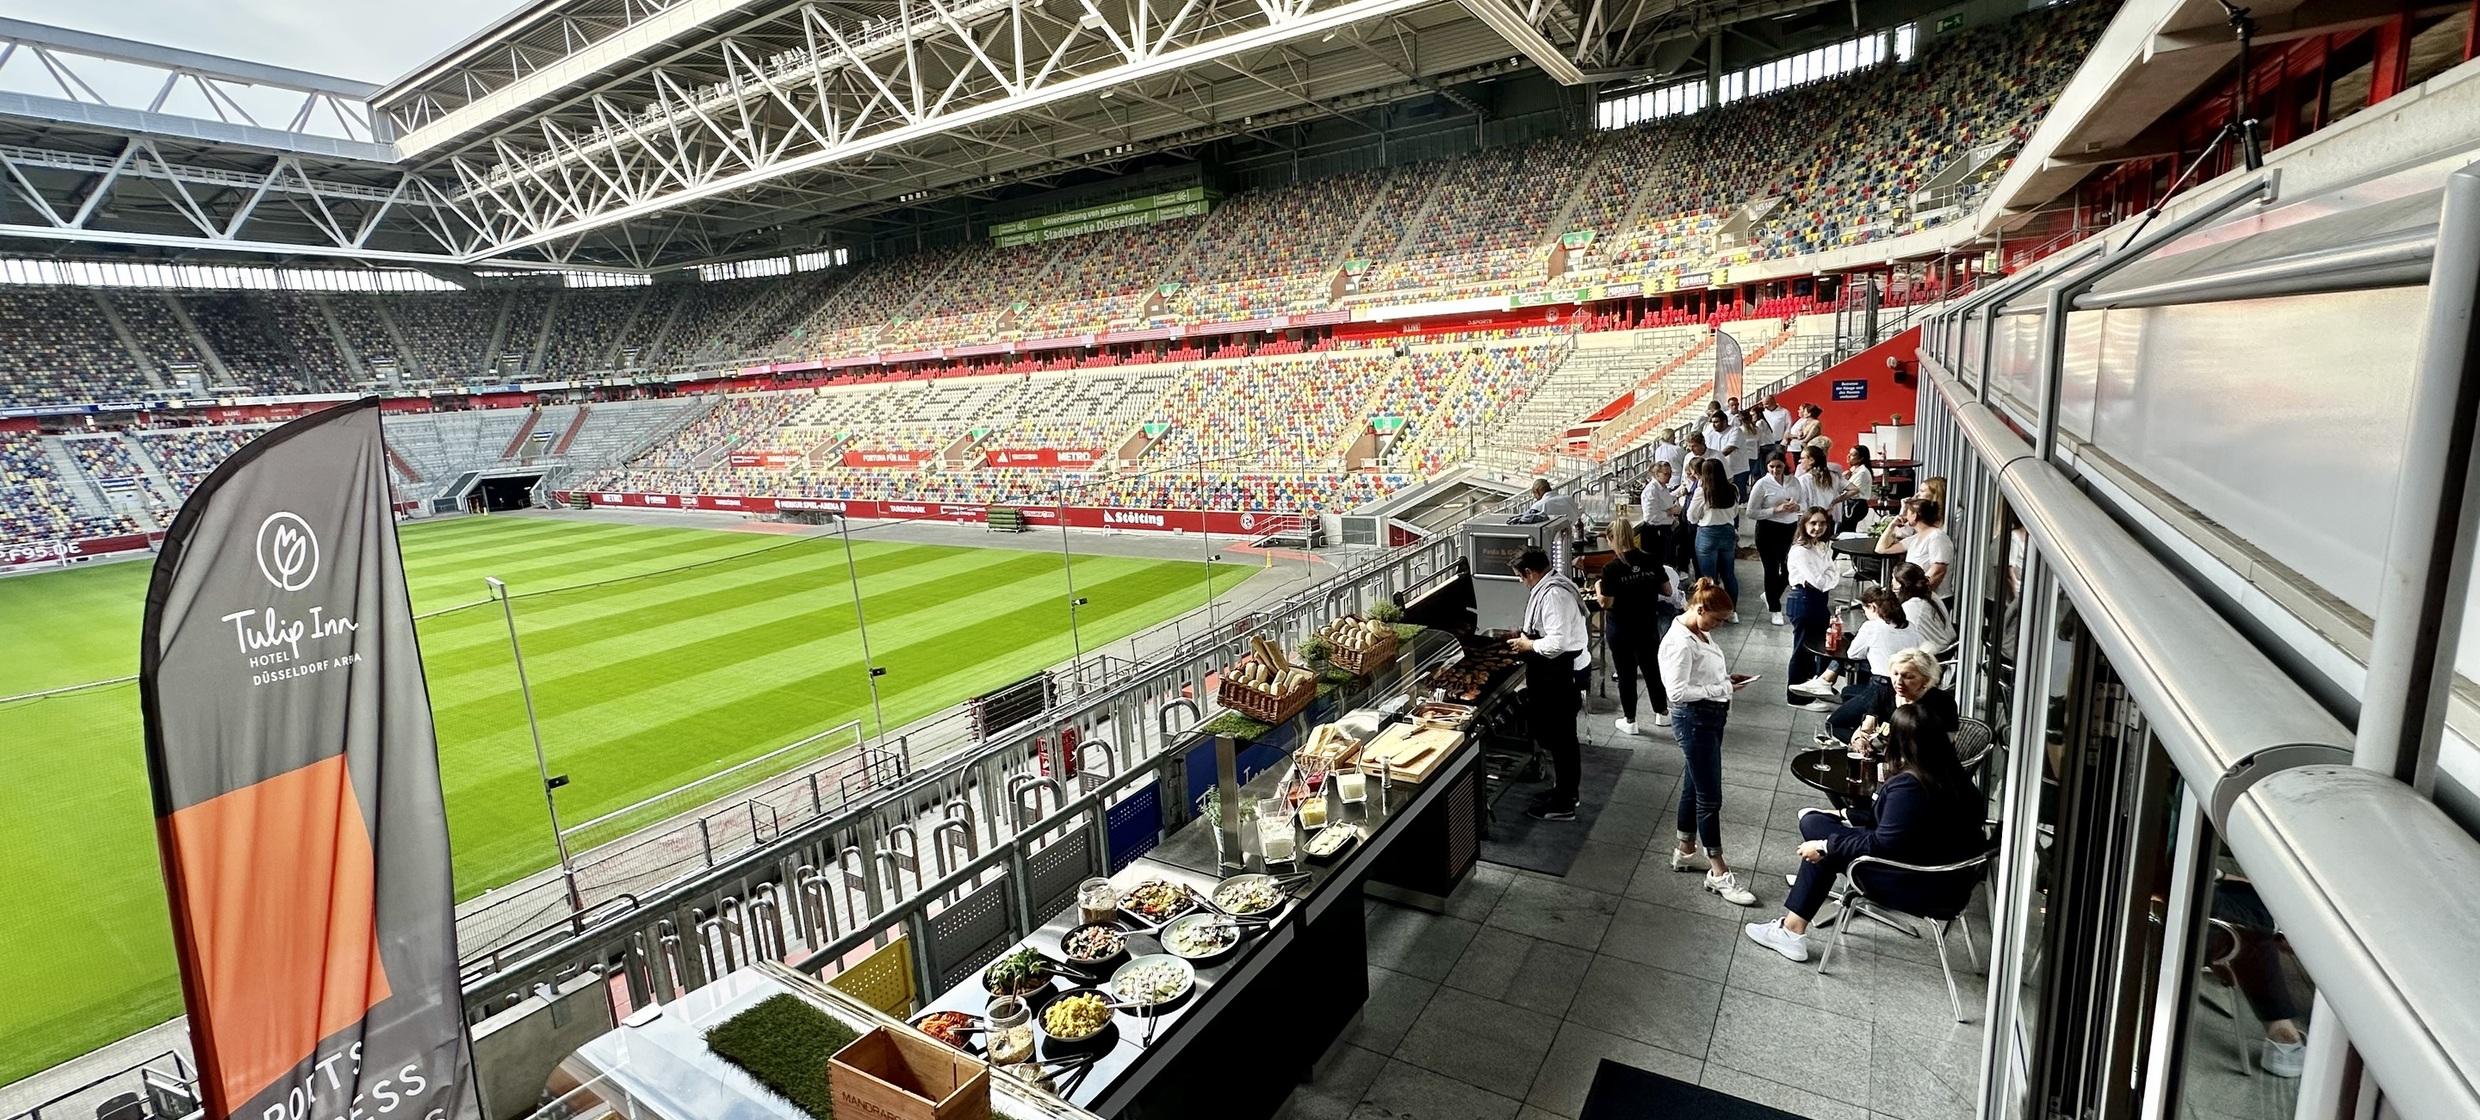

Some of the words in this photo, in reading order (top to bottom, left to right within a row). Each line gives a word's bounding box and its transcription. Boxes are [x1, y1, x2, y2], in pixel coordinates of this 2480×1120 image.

[1043, 222, 1095, 240] Stadtwerke
[1096, 212, 1149, 231] Düsseldorf
[1057, 452, 1091, 461] METRO
[1114, 511, 1164, 527] Stölting
[221, 607, 304, 659] Tulip
[309, 606, 359, 639] Inn
[249, 651, 291, 668] HOTEL
[333, 652, 362, 668] AREA
[252, 660, 329, 686] DÜSSELDORF
